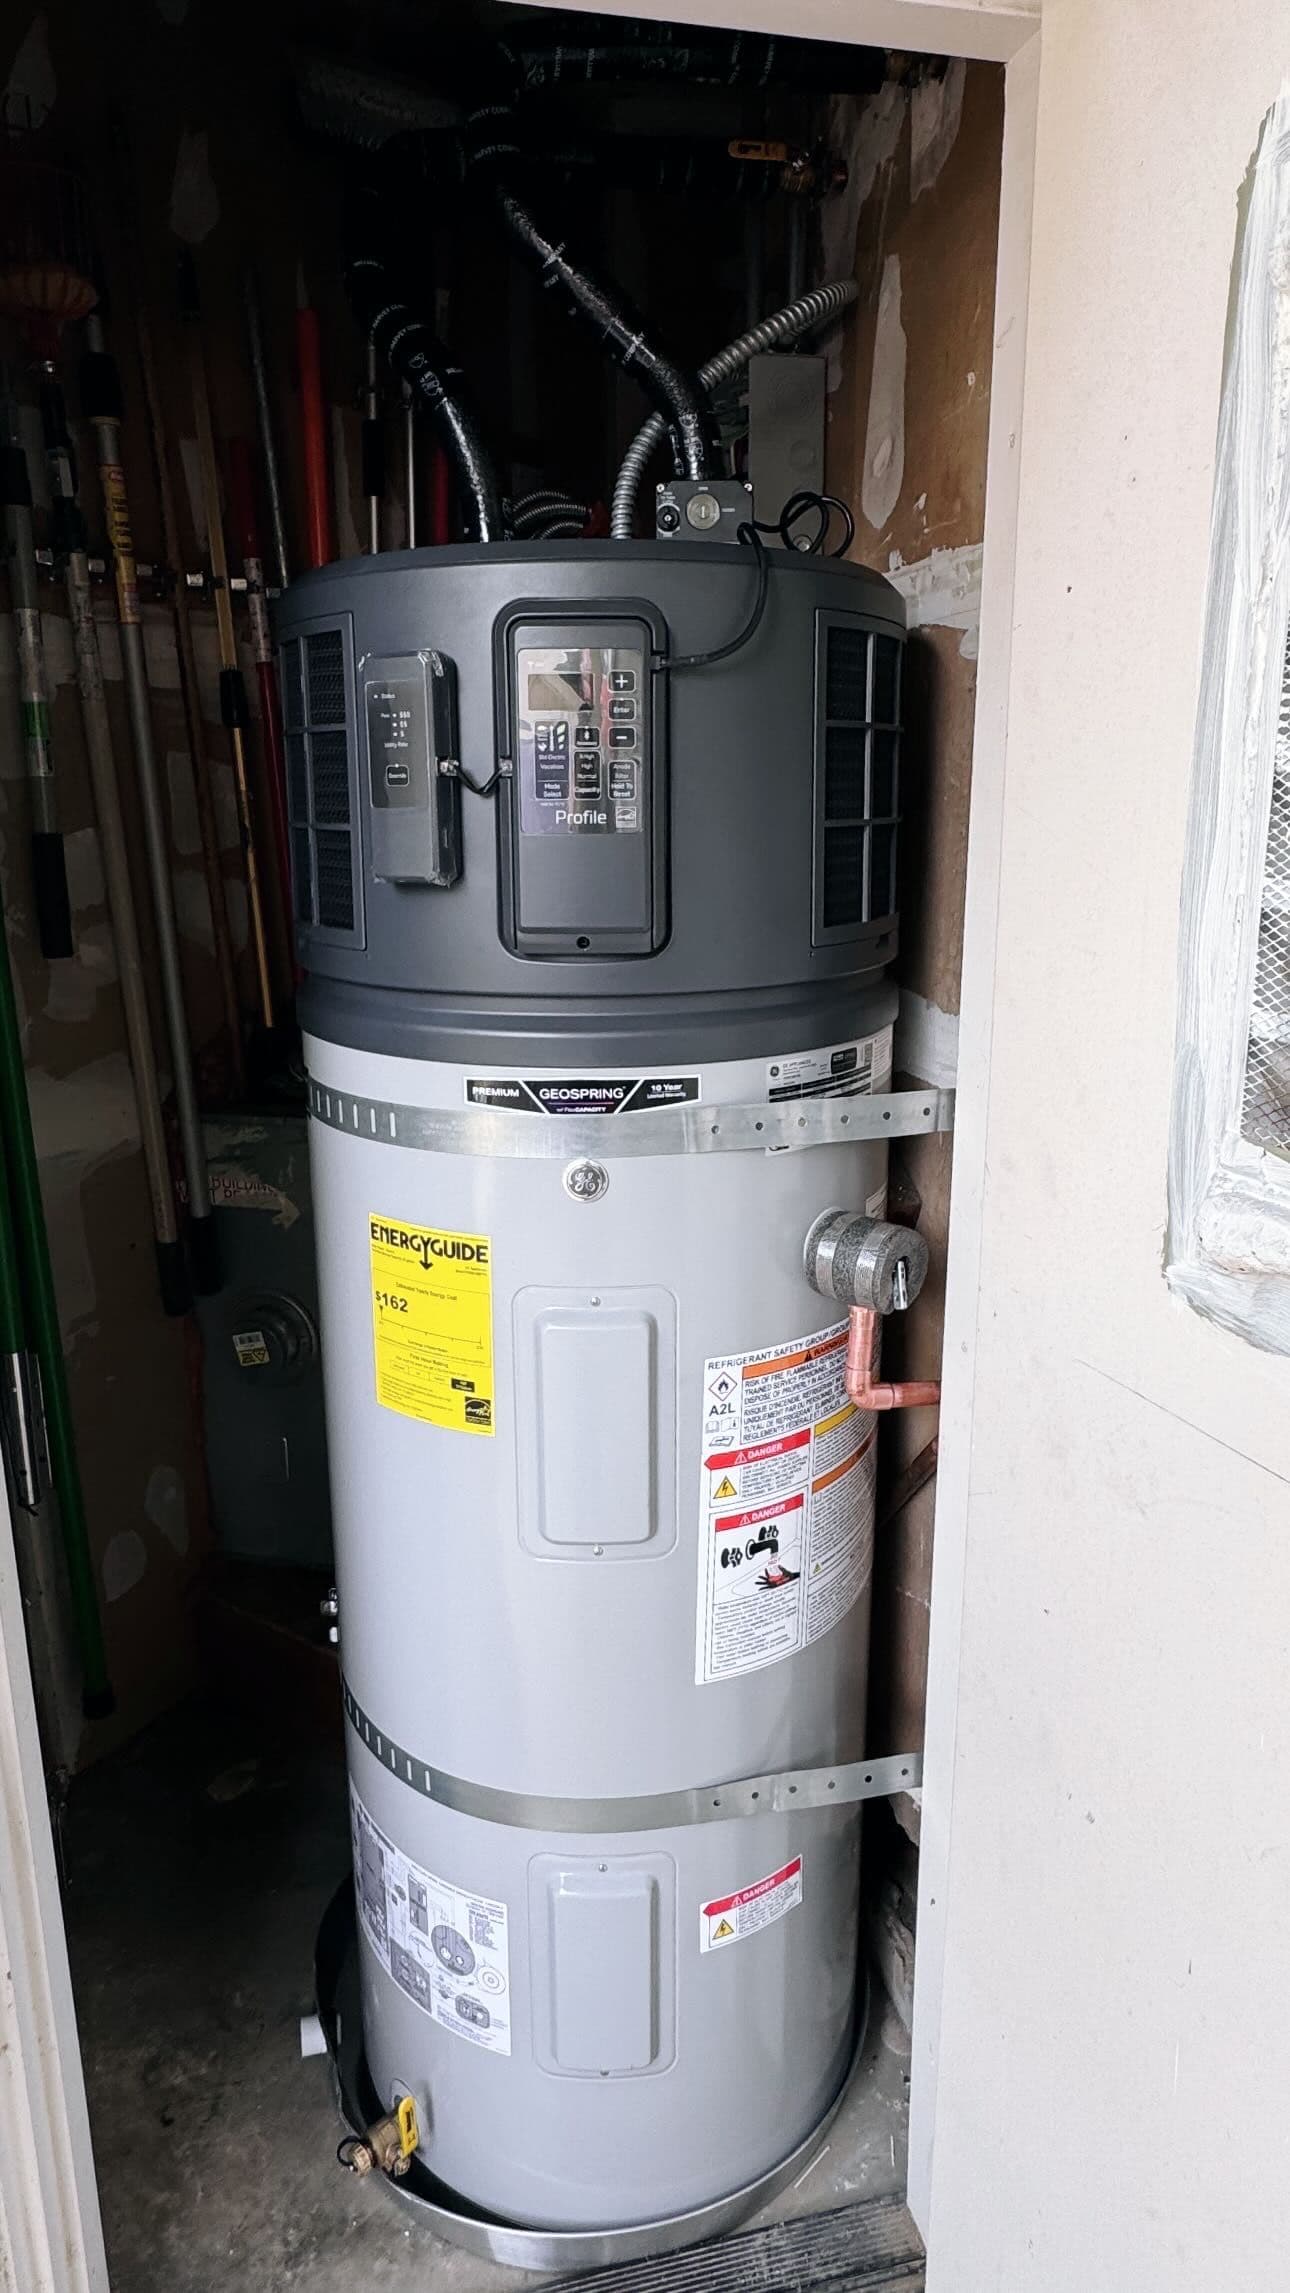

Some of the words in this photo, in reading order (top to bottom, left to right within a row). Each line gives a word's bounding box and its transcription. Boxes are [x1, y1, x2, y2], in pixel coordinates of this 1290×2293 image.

[555, 810, 608, 825] Profile
[472, 1086, 520, 1098] PREMIUM
[539, 1087, 625, 1100] GEOSPRING
[651, 1084, 662, 1093] 10
[663, 1083, 683, 1092] Year
[370, 1222, 489, 1264] ENERGYGUIDE
[375, 1290, 409, 1314] $162
[707, 1350, 773, 1370] REFRIGERANT
[773, 1341, 804, 1357] SAFETY
[709, 1403, 736, 1417] A2L
[747, 1442, 784, 1460] DANGER
[751, 1503, 786, 1522] DANGER
[742, 1879, 776, 1901] DANGER
